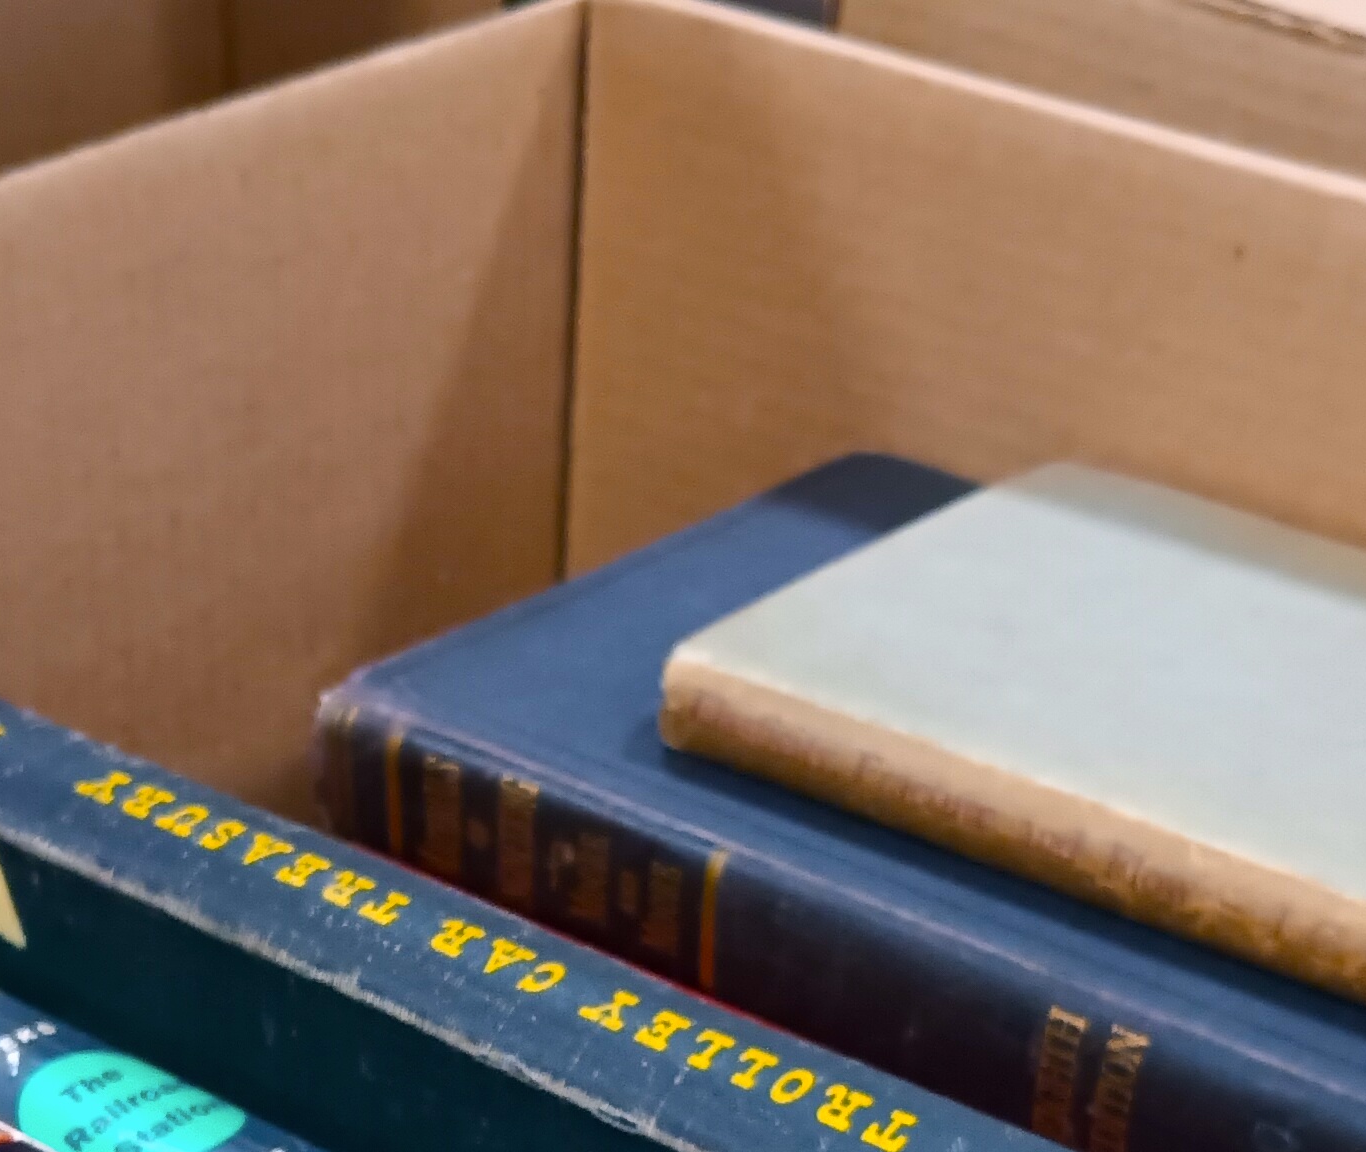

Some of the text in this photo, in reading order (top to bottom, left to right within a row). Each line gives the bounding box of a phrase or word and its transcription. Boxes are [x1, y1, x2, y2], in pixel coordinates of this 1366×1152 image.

[74, 770, 411, 926] TREASURY
[430, 917, 567, 994] CAR
[59, 1069, 124, 1103] The
